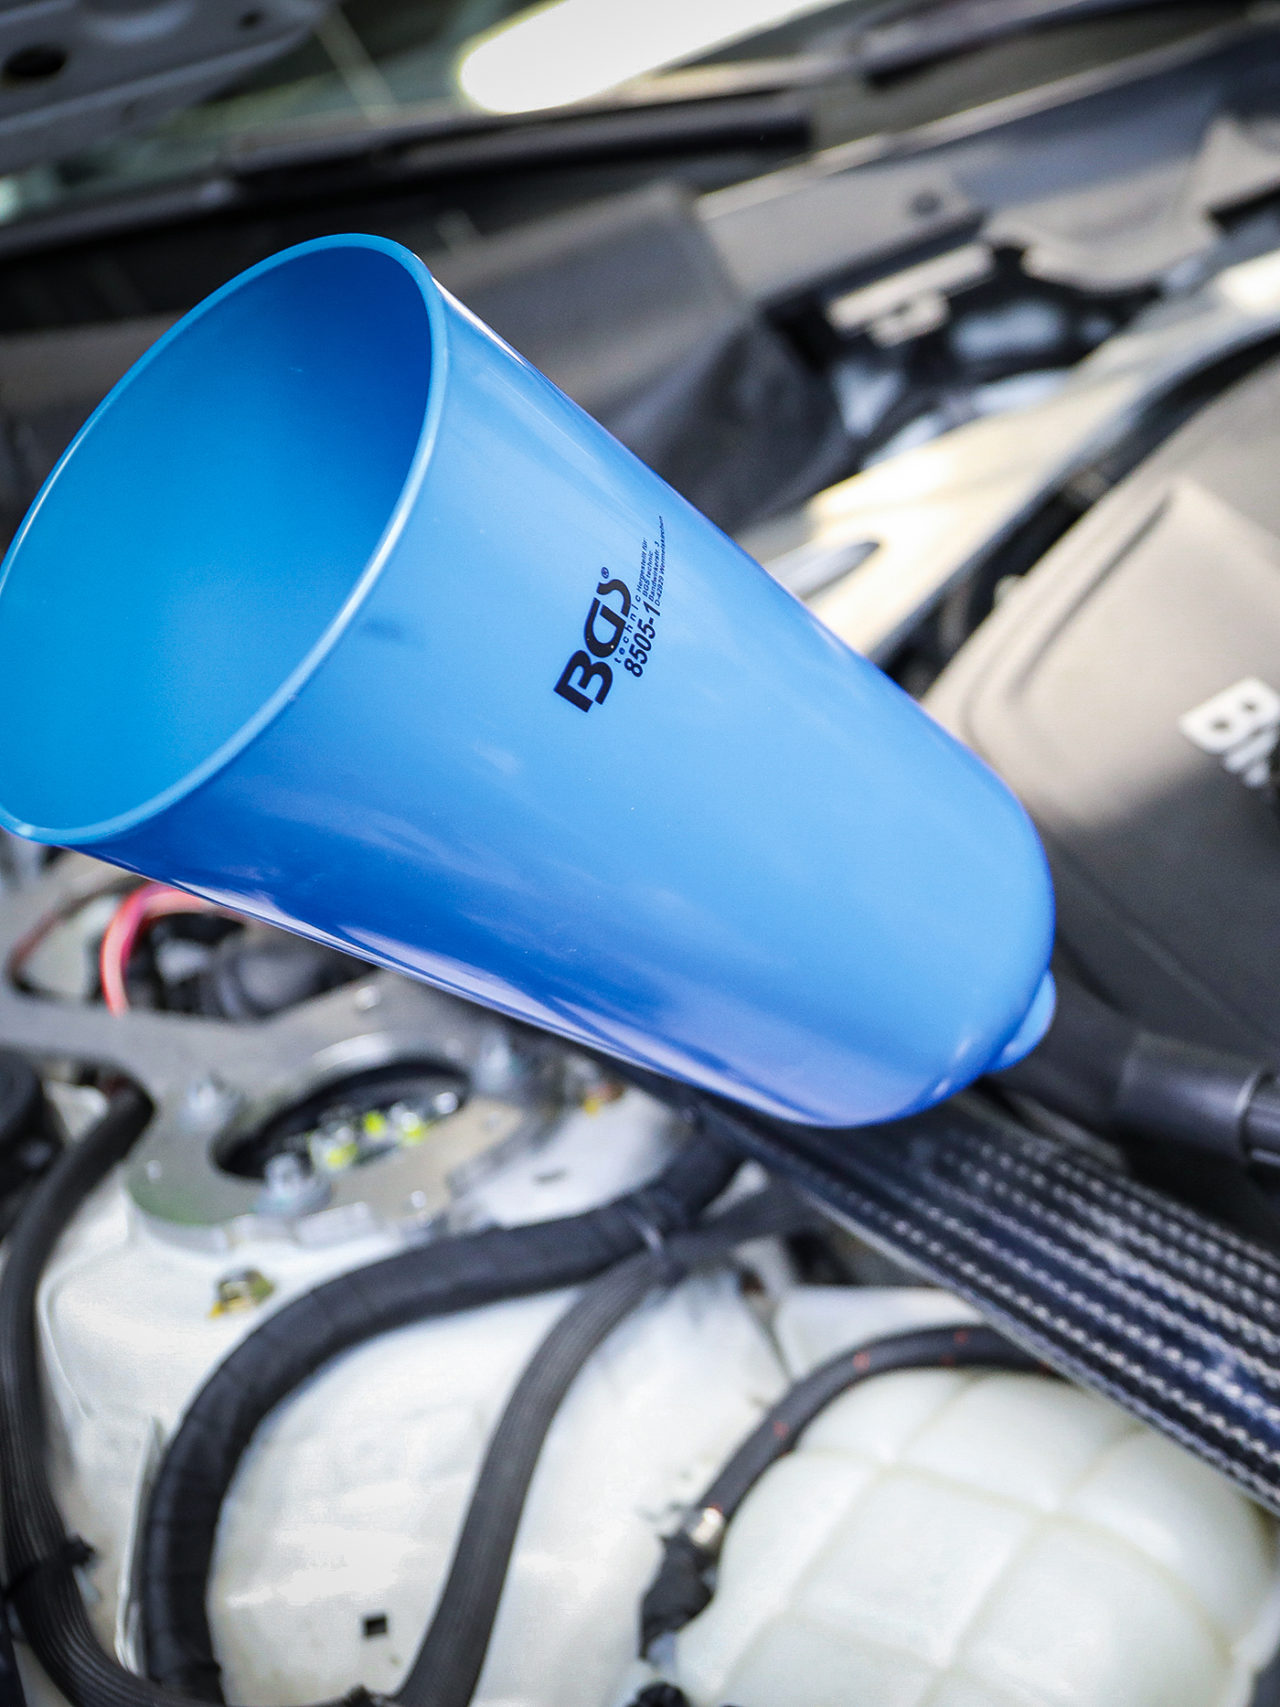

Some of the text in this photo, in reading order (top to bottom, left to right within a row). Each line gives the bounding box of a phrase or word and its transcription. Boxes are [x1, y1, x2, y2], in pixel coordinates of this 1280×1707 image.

[642, 578, 650, 597] BGS
[614, 595, 642, 664] technic
[624, 600, 661, 678] 8505-1
